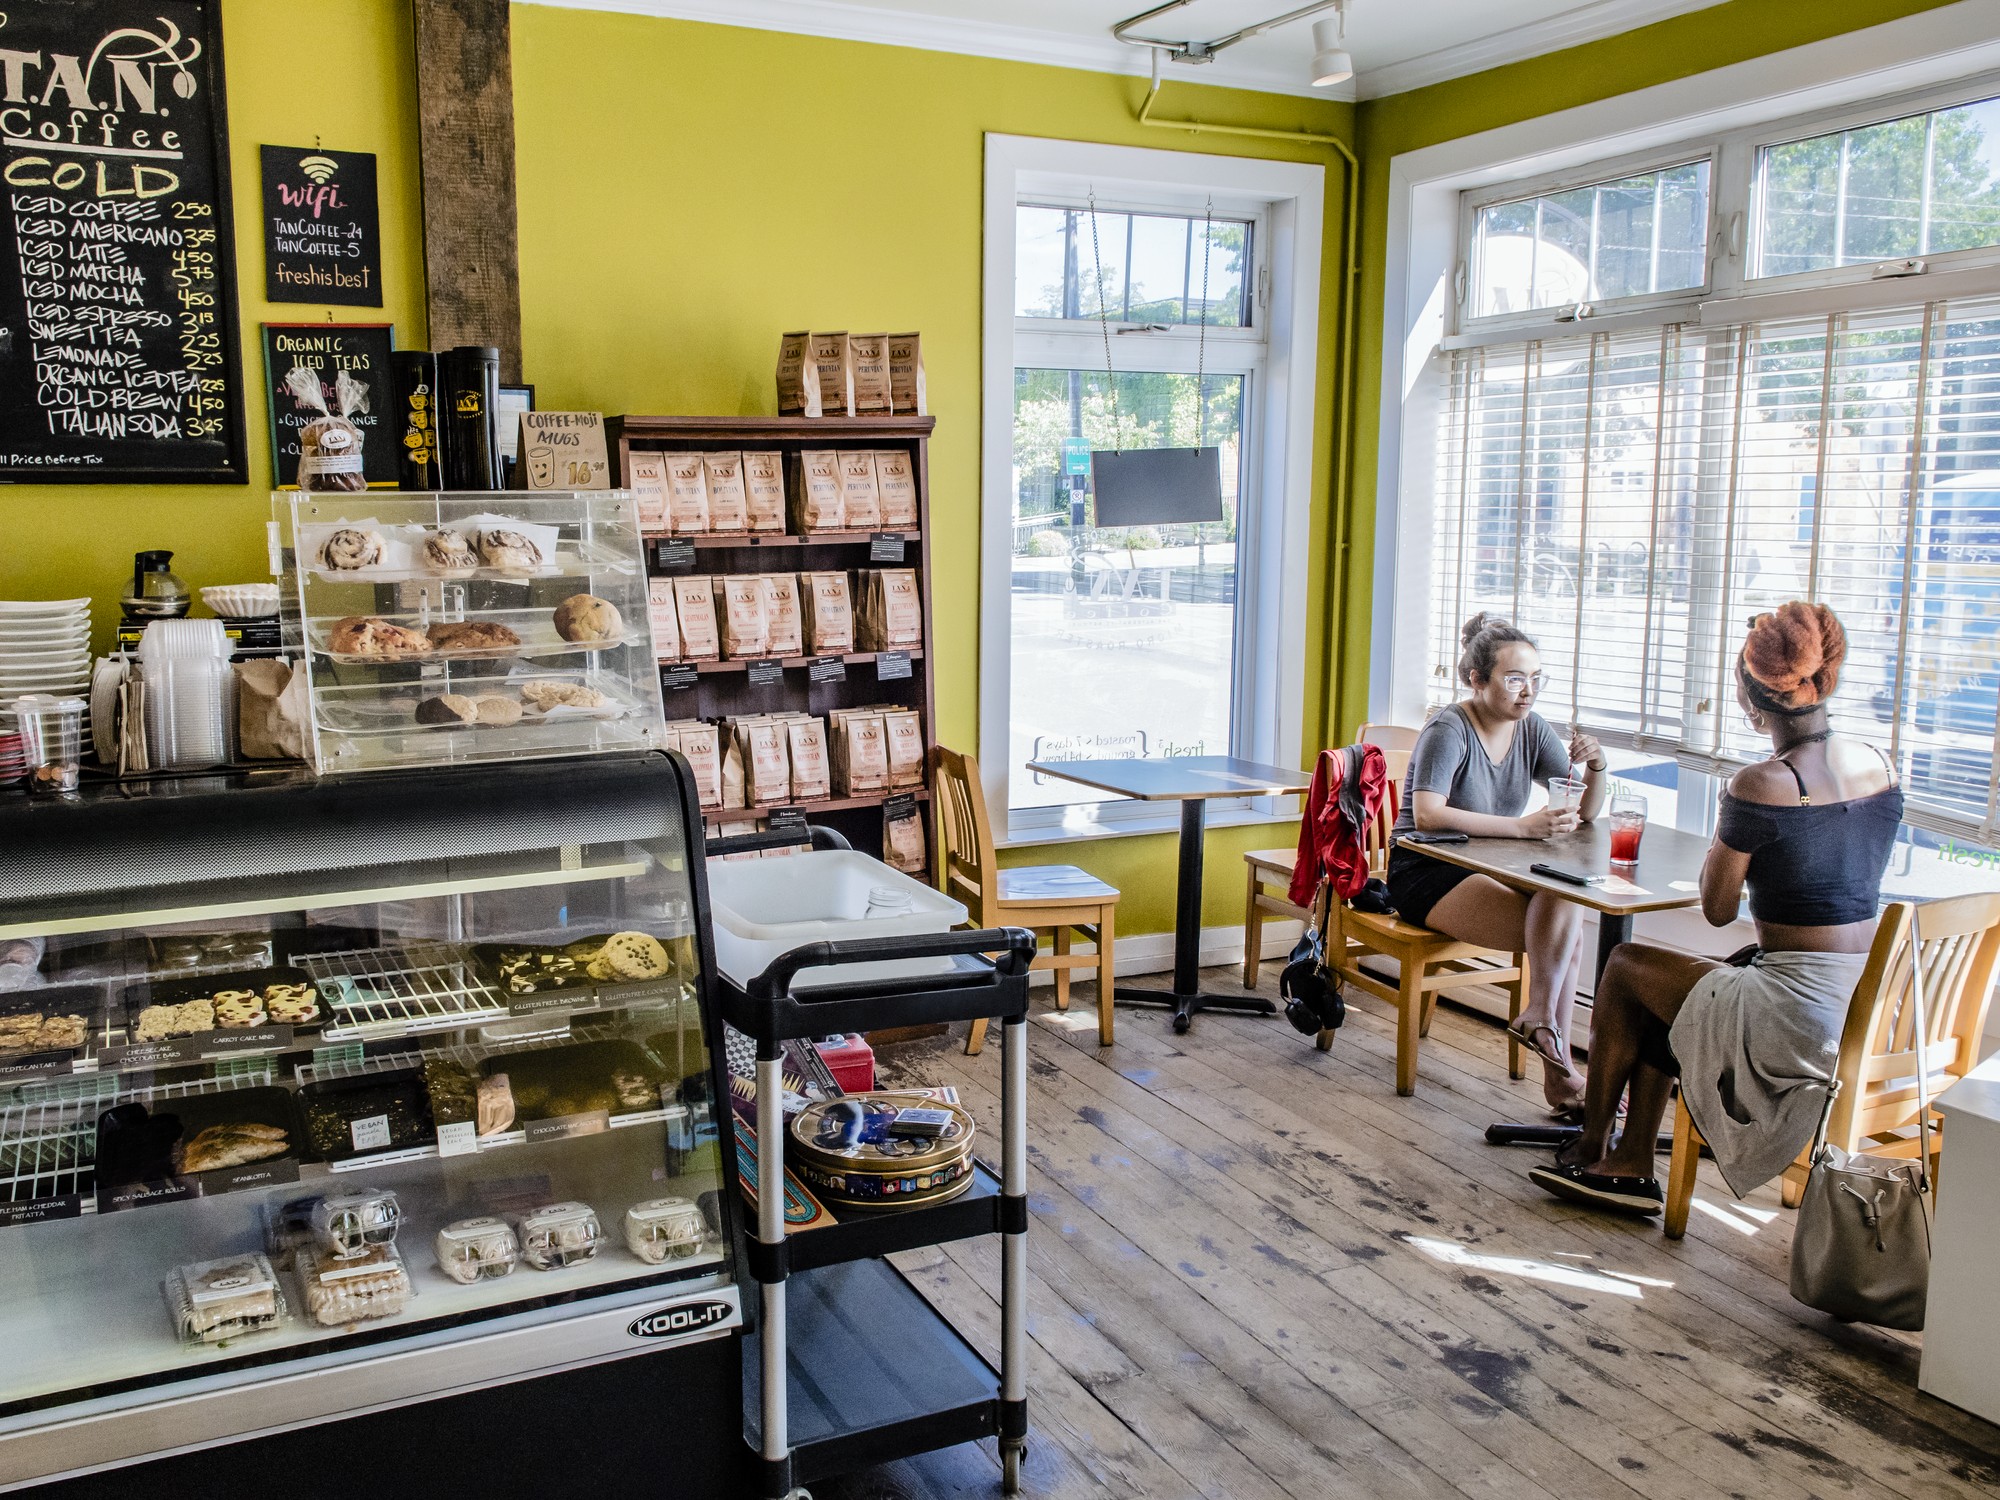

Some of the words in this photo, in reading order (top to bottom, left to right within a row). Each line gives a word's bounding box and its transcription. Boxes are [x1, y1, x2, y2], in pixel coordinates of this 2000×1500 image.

[0, 108, 181, 149] Coffee
[4, 156, 179, 199] COLD
[11, 194, 66, 214] ICED
[68, 201, 161, 222] COFFEE
[15, 214, 66, 236] ICED
[71, 219, 183, 247] AMERICANO
[17, 236, 63, 259] ICED
[69, 241, 127, 264] LATTE
[20, 256, 64, 280] ICED
[69, 263, 146, 286] MATCHA
[22, 278, 66, 299] ICED
[70, 282, 144, 306] MOCHA
[27, 300, 71, 321] ICED
[73, 306, 172, 327] ESPRESSO
[28, 320, 99, 345] SWEET
[100, 327, 143, 349] TEA
[276, 335, 343, 352] ORGANIC
[33, 343, 147, 369] LEMONADE
[293, 355, 324, 370] ICED
[332, 354, 370, 370] TEAS
[37, 363, 116, 387] ORGANIC
[37, 383, 108, 408] COLD
[109, 388, 182, 412] BREW
[127, 412, 182, 439] SODA
[537, 431, 581, 446] MUGS
[1067, 445, 1089, 456] POLICE
[12, 456, 43, 465] Price
[83, 455, 103, 465] Tax
[514, 1001, 541, 1010] GLUTEN
[542, 999, 559, 1008] FREE
[126, 1045, 172, 1056] CHEESECAKE
[212, 1036, 238, 1044] CARROT
[119, 1053, 161, 1064] CHOCOLATE
[356, 1120, 384, 1131] VEGAN
[533, 1125, 567, 1134] CHOCOLATE
[132, 1189, 164, 1199] SAUSAGE
[164, 1186, 185, 1194] ROLLS
[637, 1304, 726, 1336] KOOL-IT
